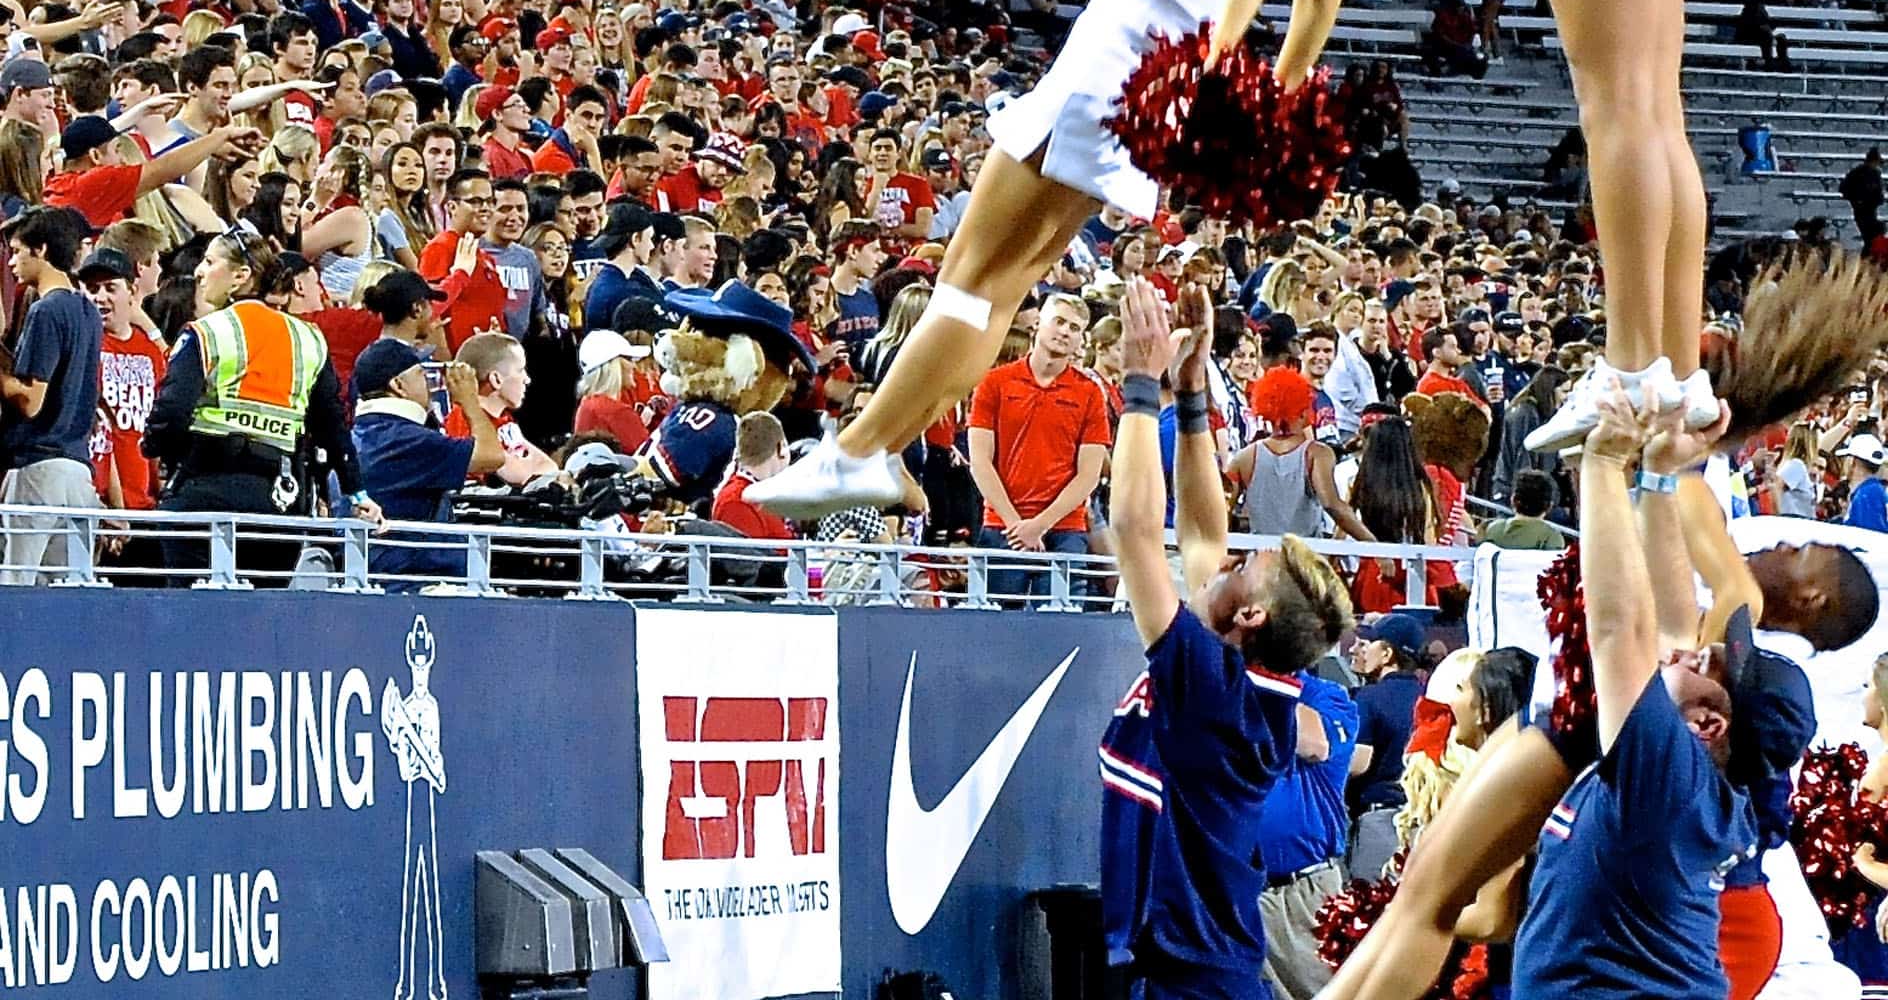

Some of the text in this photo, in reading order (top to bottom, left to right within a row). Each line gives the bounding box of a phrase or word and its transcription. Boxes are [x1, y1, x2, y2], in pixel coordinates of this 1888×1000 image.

[102, 382, 155, 417] BEAR
[112, 407, 146, 433] OW
[225, 411, 291, 436] POLICE
[0, 667, 375, 825] S PLUMBING
[662, 695, 828, 860] ESPN
[664, 888, 692, 920] THE
[91, 869, 280, 982] COOLING
